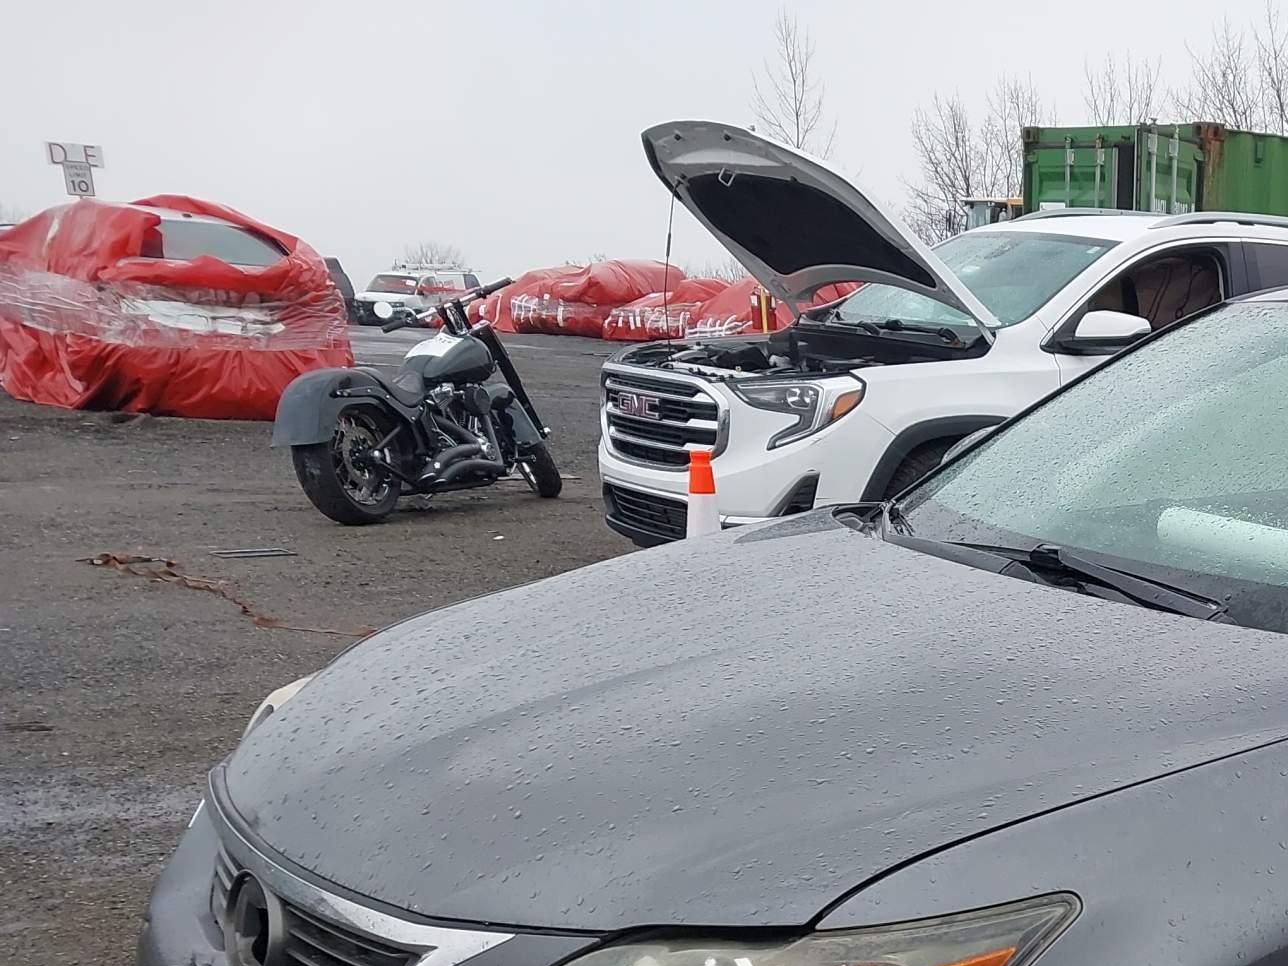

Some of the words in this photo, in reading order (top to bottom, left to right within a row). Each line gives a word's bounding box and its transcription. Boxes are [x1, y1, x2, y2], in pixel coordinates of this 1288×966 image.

[48, 142, 67, 164] D
[71, 180, 88, 192] 10
[618, 392, 660, 420] GMC
